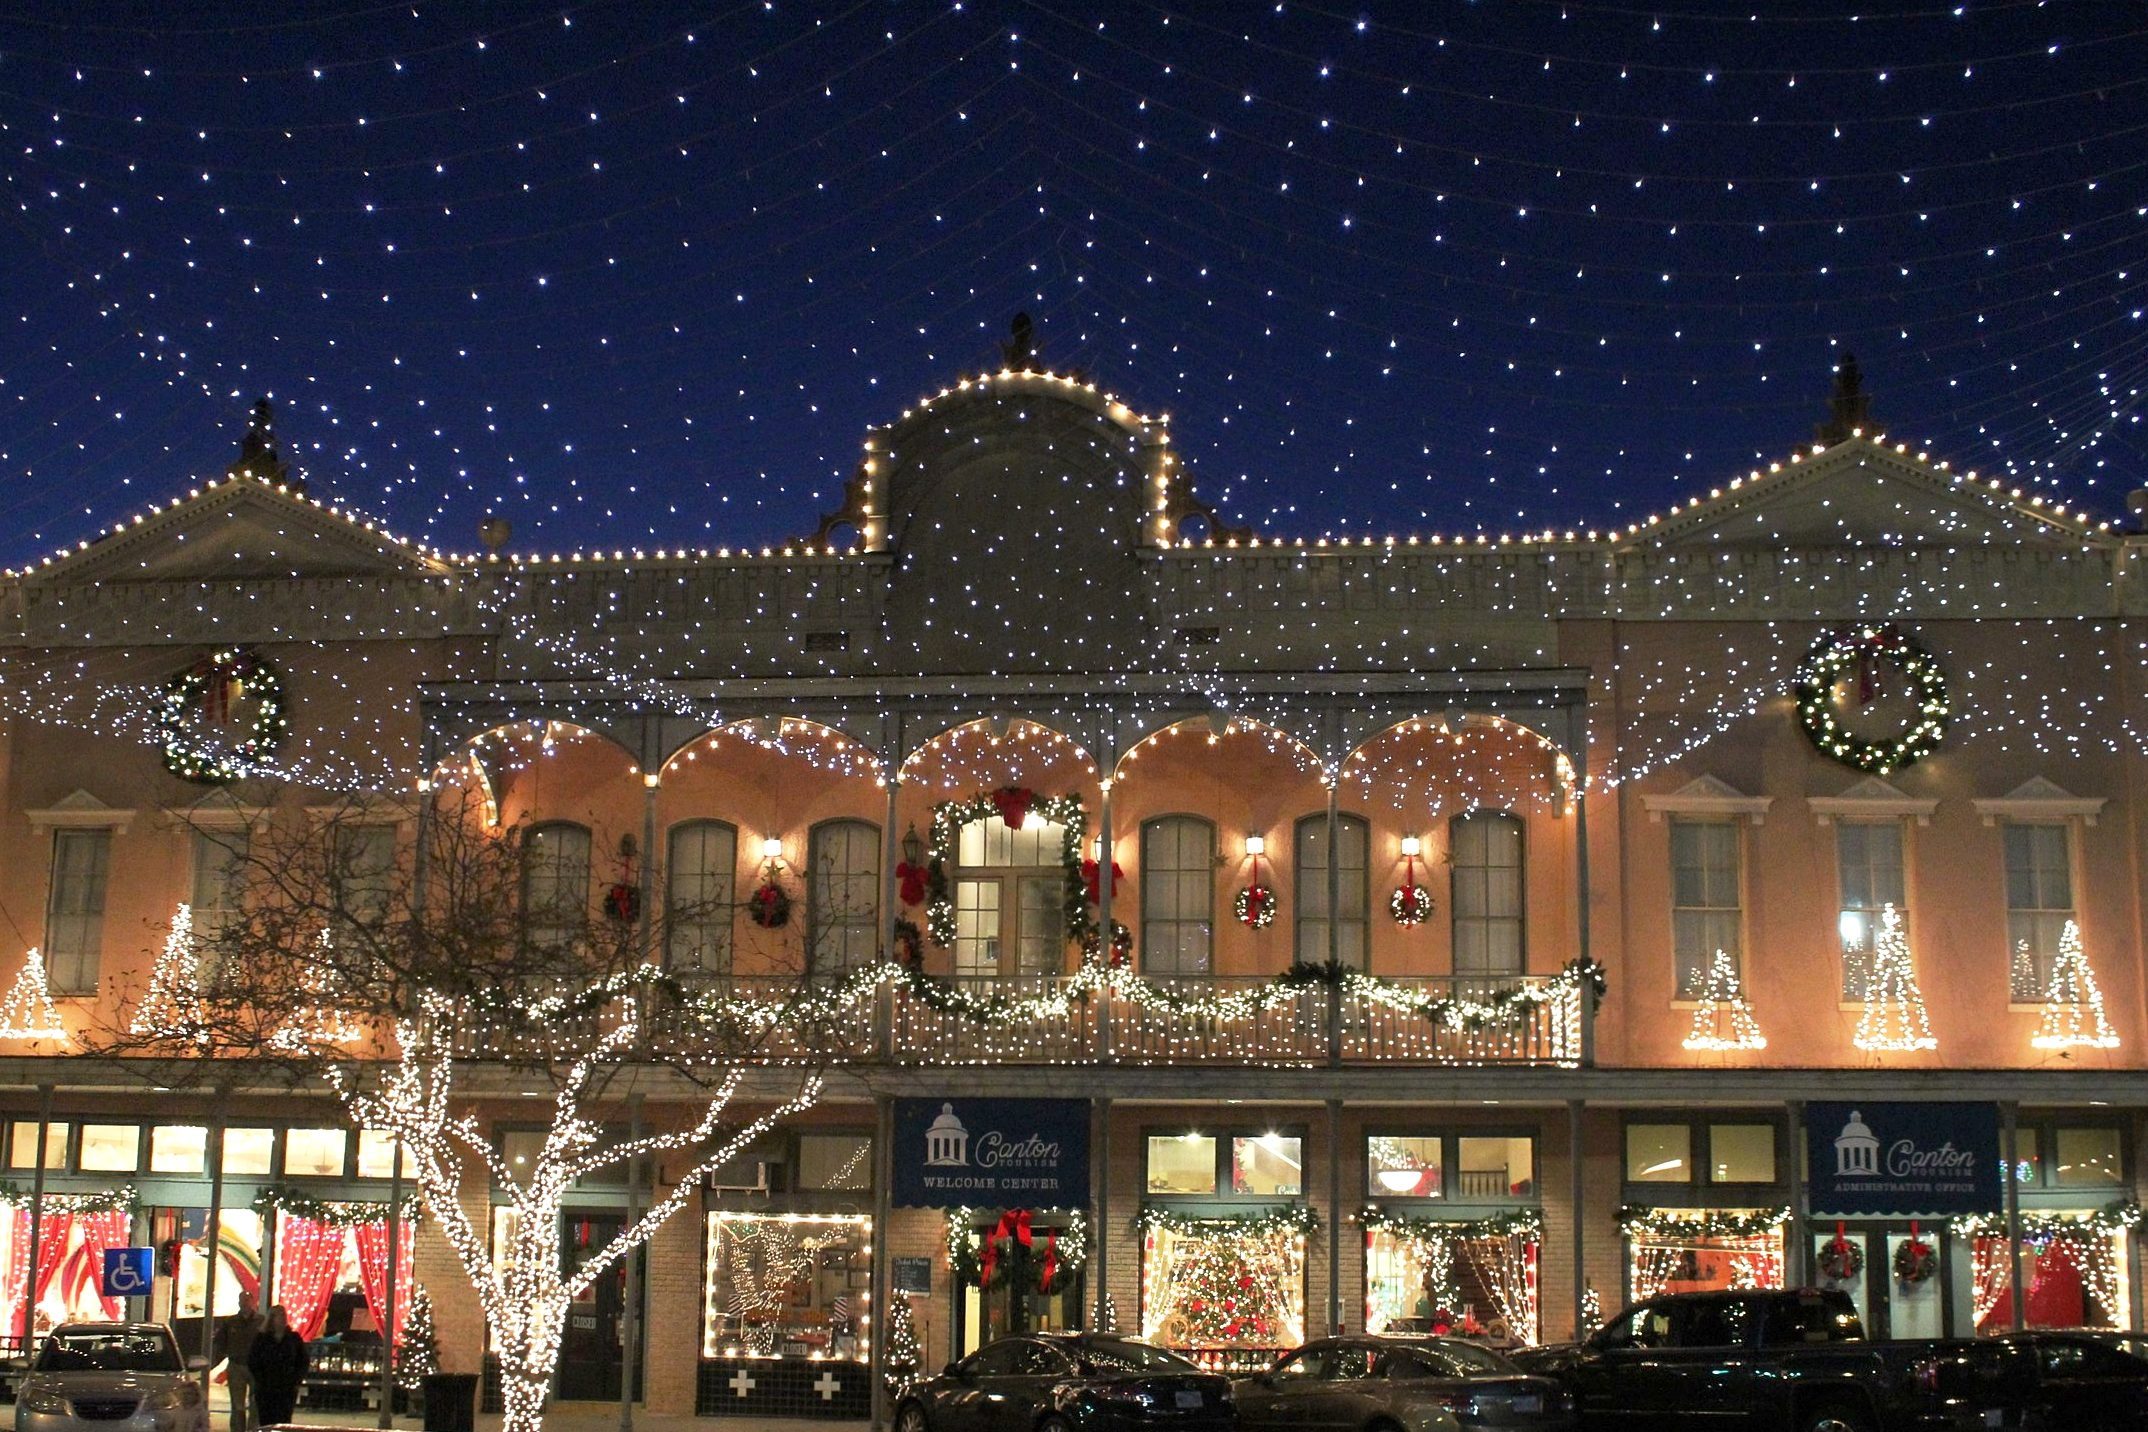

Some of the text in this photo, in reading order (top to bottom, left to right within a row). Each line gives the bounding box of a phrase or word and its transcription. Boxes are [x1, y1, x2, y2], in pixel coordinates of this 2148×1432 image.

[975, 1131, 1060, 1168] Canton
[1000, 1159, 1058, 1167] TOURISM
[1887, 1139, 1975, 1177] Canton
[1911, 1168, 1972, 1177] TOURISM
[924, 1176, 1059, 1190] WELCOME CENTER
[1834, 1182, 1975, 1193] ADMINISTRATIVE OFFICE
